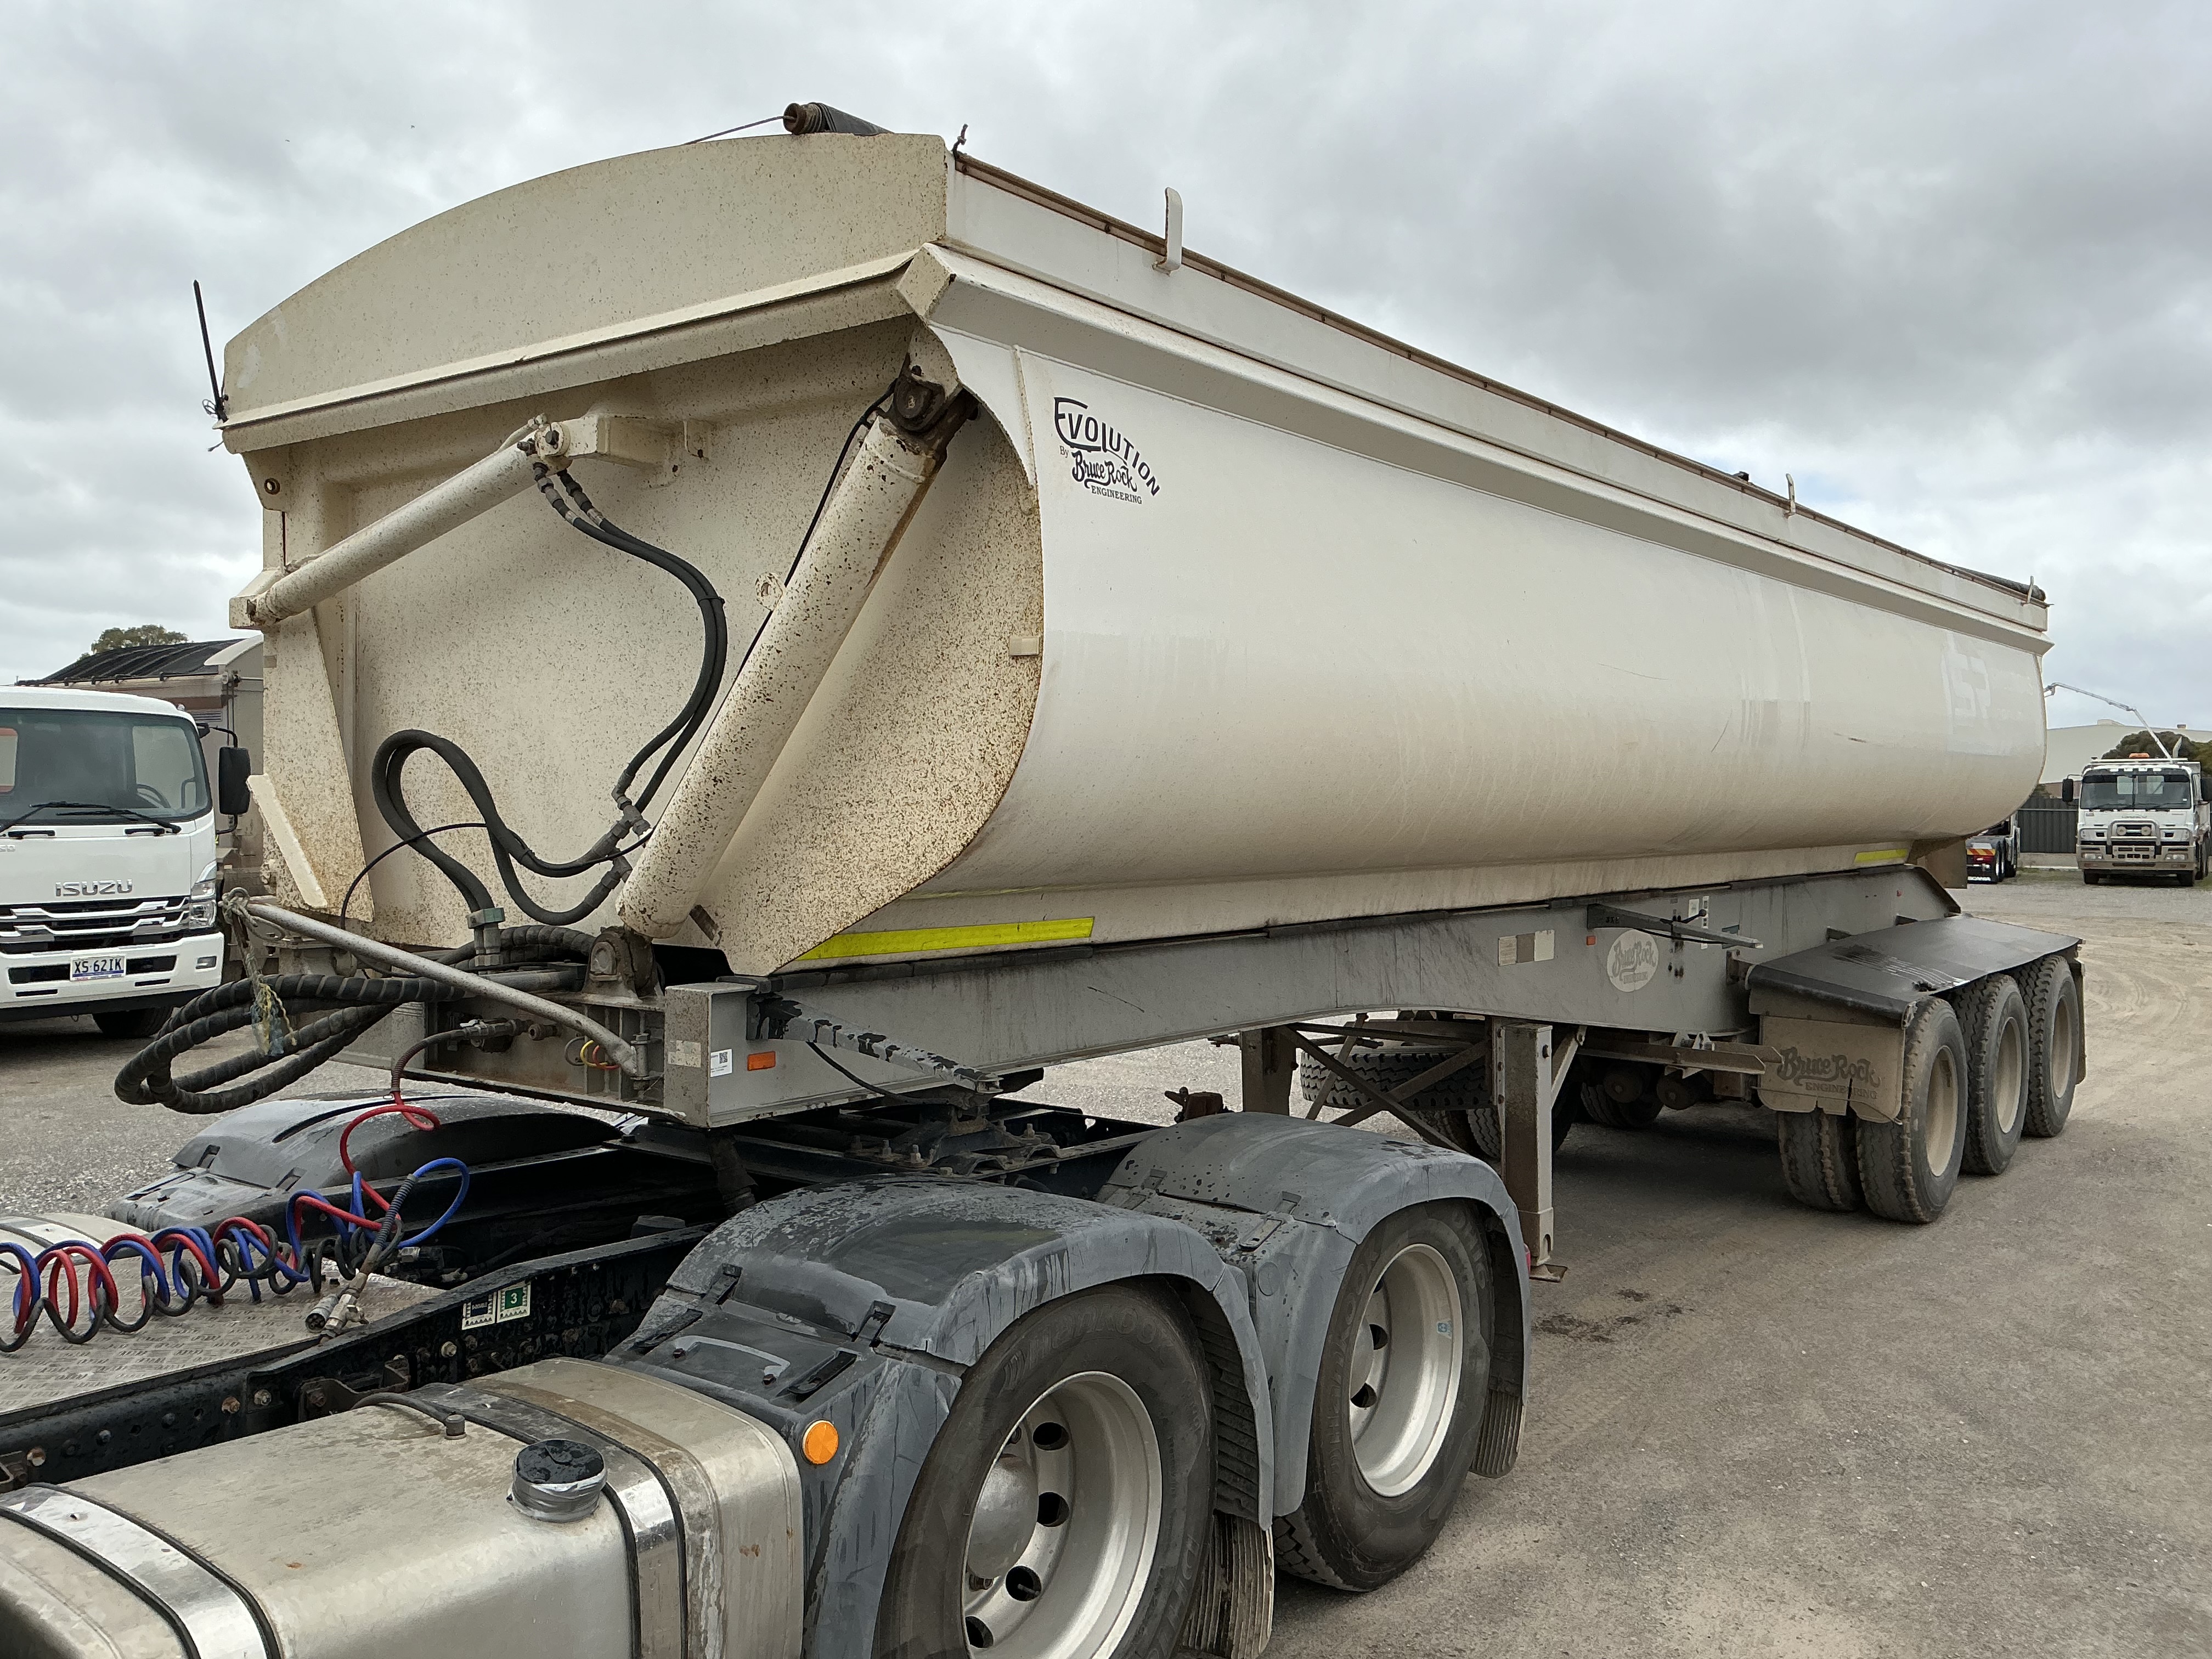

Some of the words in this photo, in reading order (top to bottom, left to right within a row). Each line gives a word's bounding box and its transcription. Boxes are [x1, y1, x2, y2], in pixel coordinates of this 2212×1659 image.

[1053, 397, 1160, 496] EVOLUTION
[1059, 445, 1069, 458] By
[1071, 450, 1106, 482] Bruce
[1103, 460, 1137, 492] Rock
[1091, 485, 1142, 505] ENGINEERING
[55, 879, 133, 897] ISUZU
[1805, 1082, 1878, 1099] ENGINERING
[510, 1292, 518, 1304] 3
